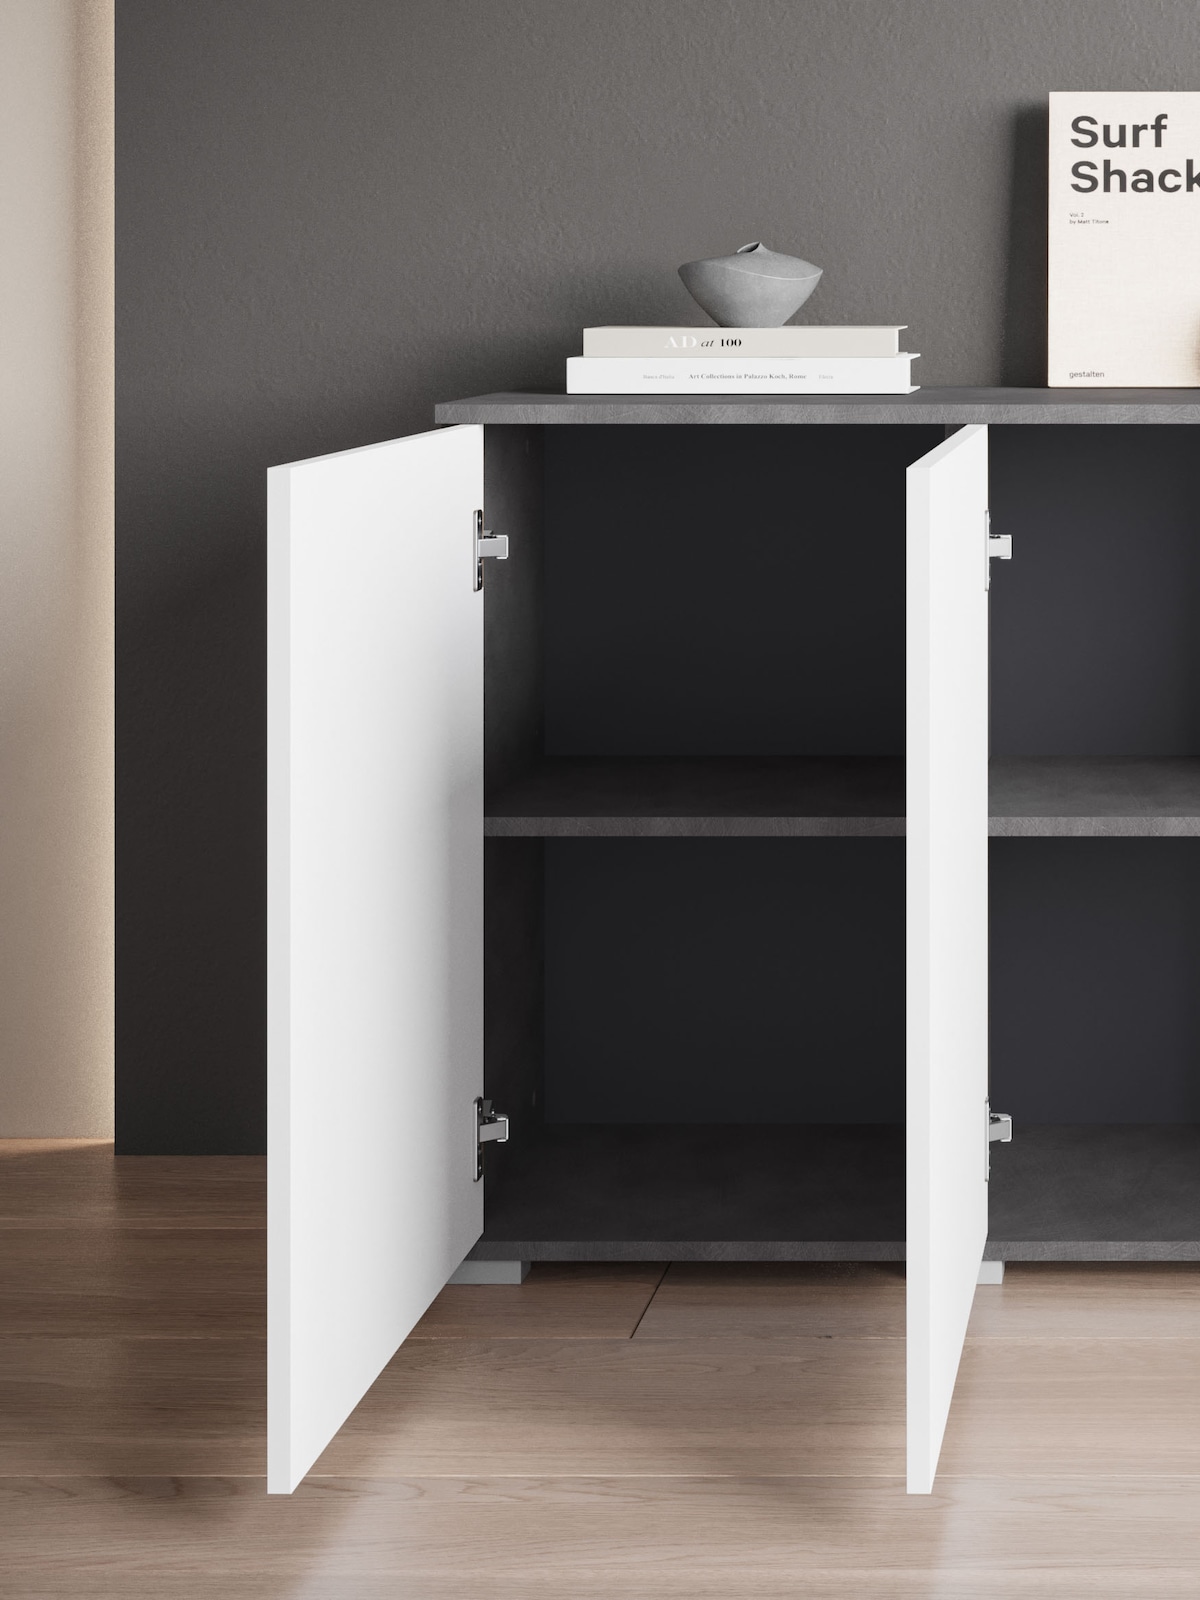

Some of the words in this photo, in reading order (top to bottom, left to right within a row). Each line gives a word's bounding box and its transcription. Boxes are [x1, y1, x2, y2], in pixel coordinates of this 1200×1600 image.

[1070, 113, 1168, 148] Surf
[664, 335, 698, 348] AD
[700, 339, 715, 348] at
[720, 338, 743, 348] 100
[768, 373, 788, 381] Koch,
[1069, 370, 1105, 379] gestalten
